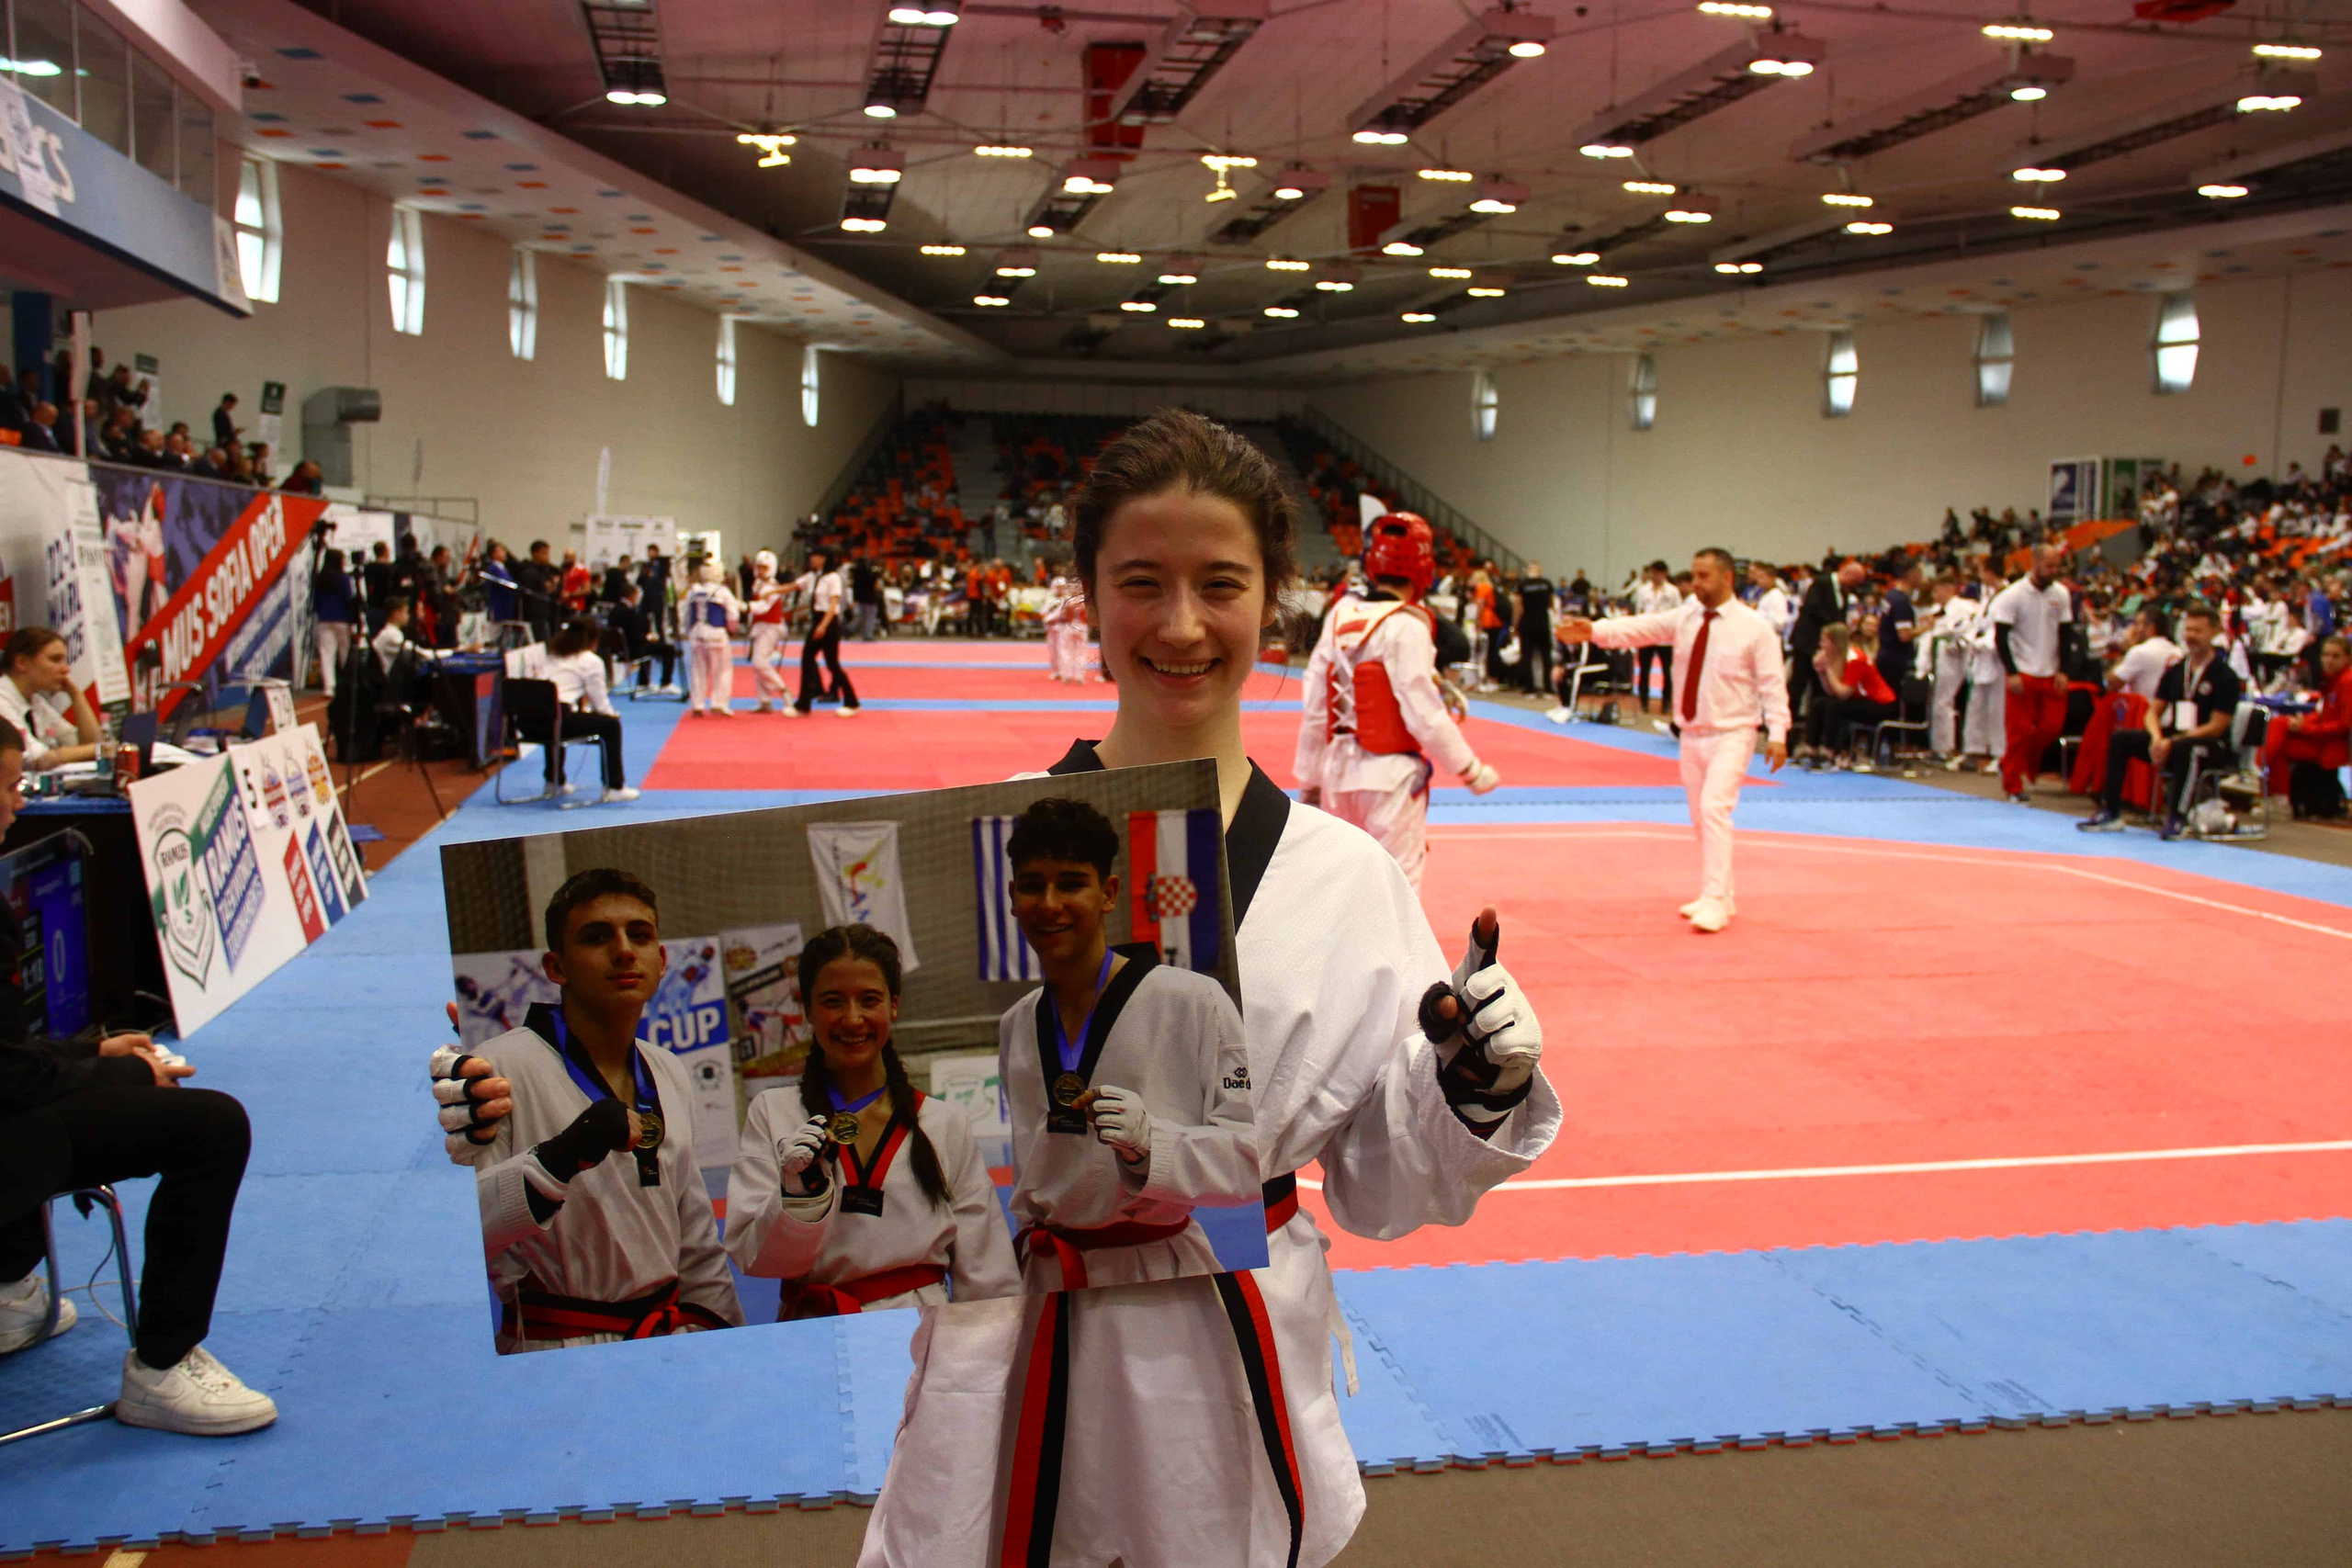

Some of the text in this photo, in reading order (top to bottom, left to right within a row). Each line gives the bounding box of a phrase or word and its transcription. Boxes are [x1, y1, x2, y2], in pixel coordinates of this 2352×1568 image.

[205, 538, 253, 639] SOFIA
[248, 494, 287, 581] OPEN
[243, 768, 257, 810] 5
[648, 1007, 721, 1052] CUP
